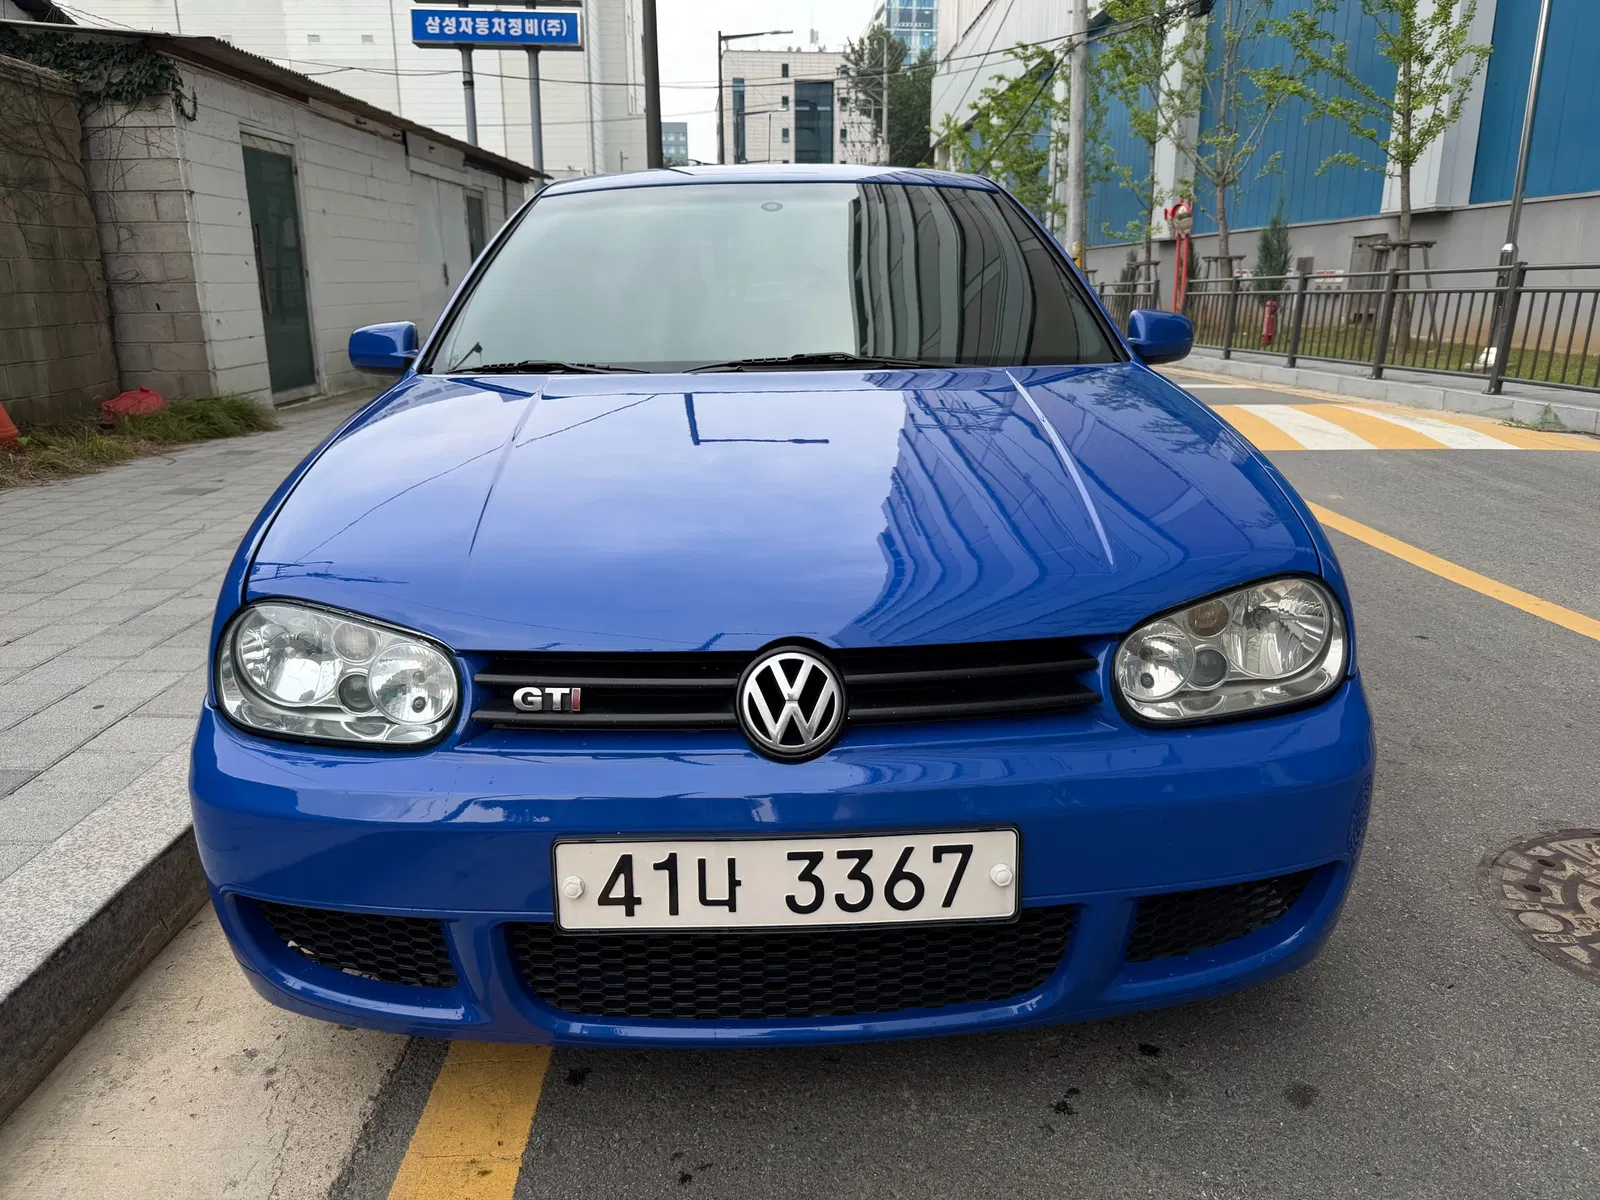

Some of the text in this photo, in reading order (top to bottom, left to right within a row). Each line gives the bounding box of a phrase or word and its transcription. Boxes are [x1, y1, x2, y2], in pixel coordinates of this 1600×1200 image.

[425, 16, 567, 36] 삼성자동차정비(주)
[512, 686, 582, 712] GTI
[597, 844, 974, 917] 41나 3367
